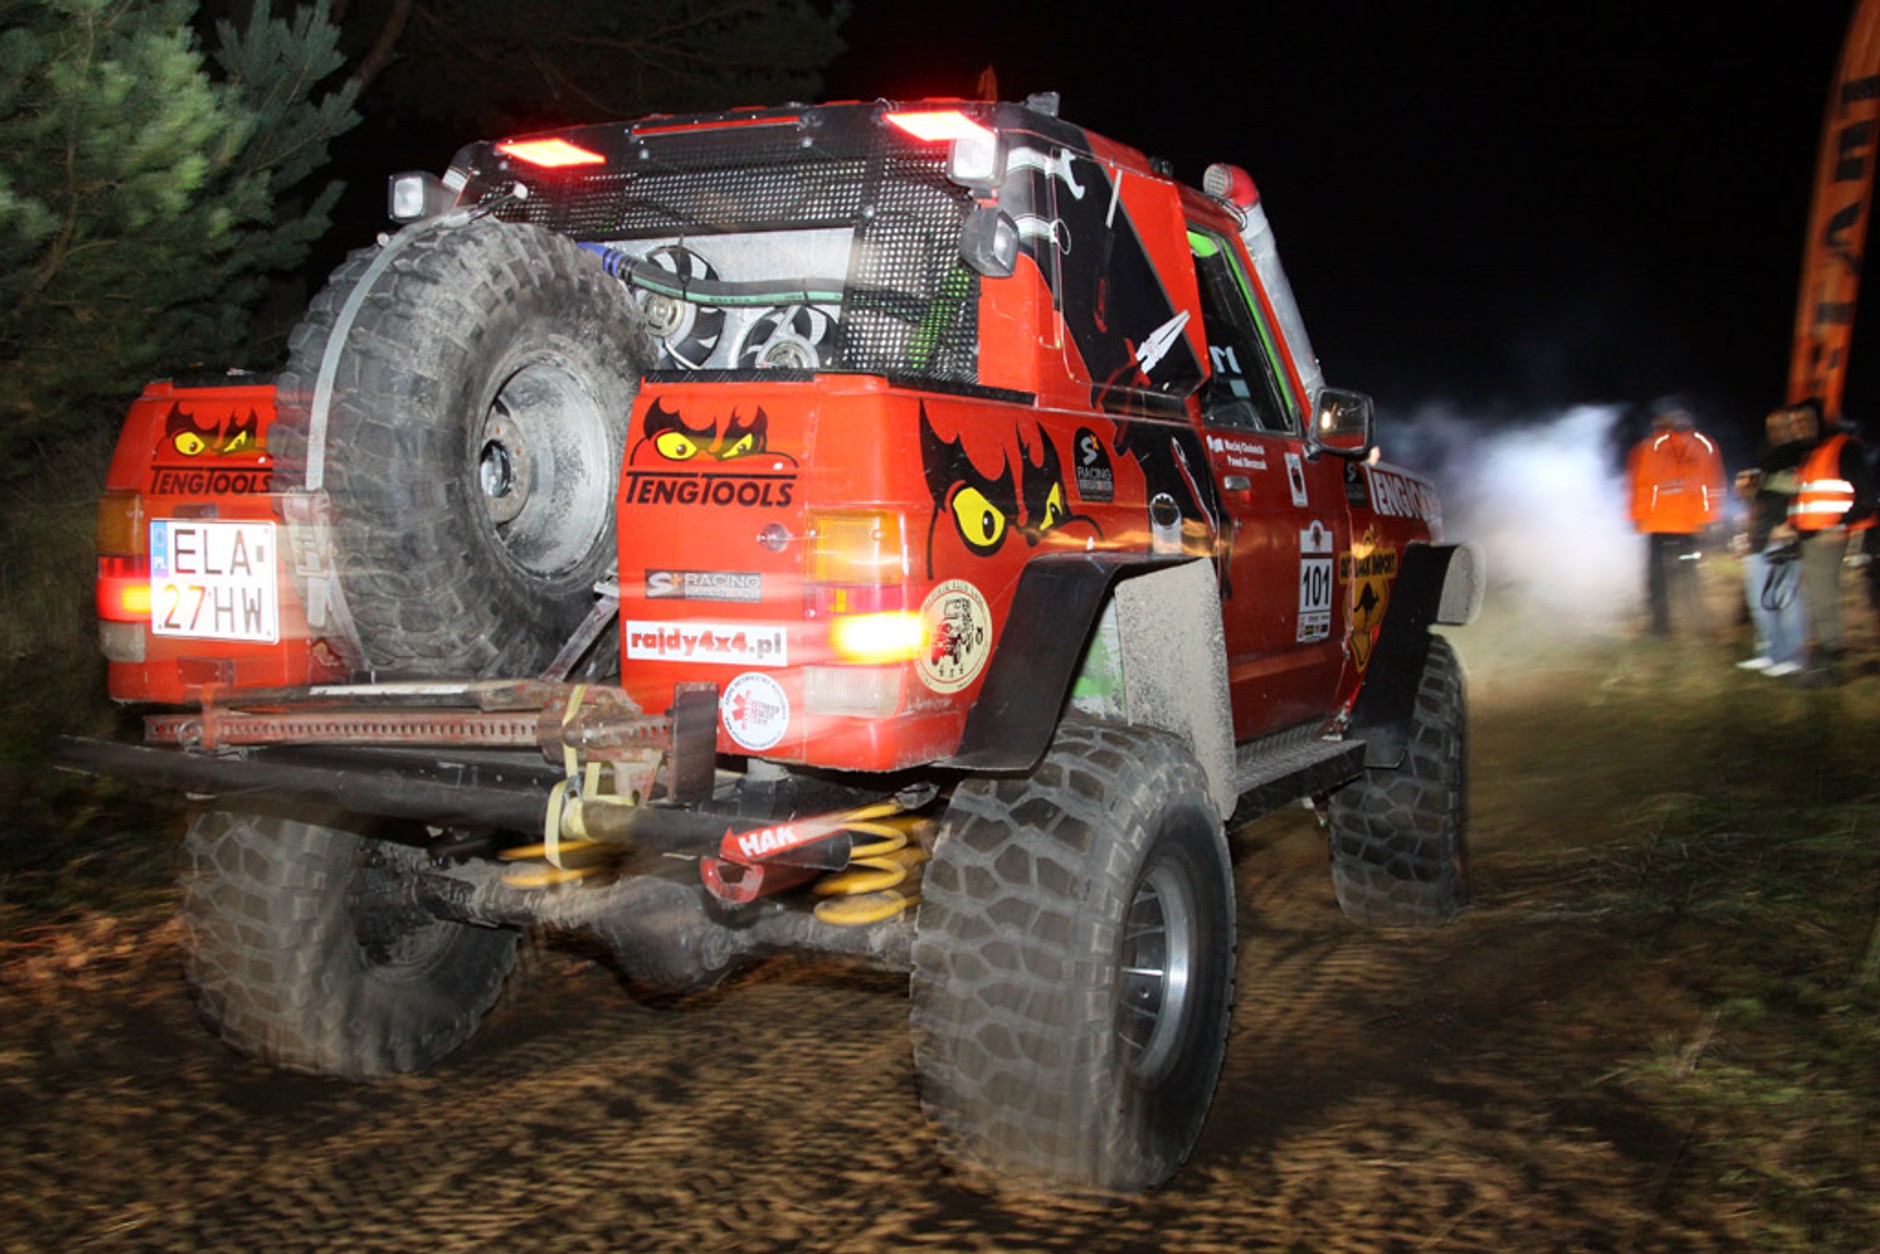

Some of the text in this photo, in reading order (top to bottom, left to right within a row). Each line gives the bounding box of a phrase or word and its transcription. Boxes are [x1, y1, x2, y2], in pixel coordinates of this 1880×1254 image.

[150, 465, 273, 495] TENGTOOLS
[626, 471, 798, 507] TENGTOOLS
[174, 529, 252, 576] ELA
[685, 573, 761, 589] RACING
[1303, 565, 1330, 607] 101
[164, 583, 262, 635] 27HW
[631, 626, 782, 659] rajdy4x4.pl
[738, 826, 797, 857] HAK
